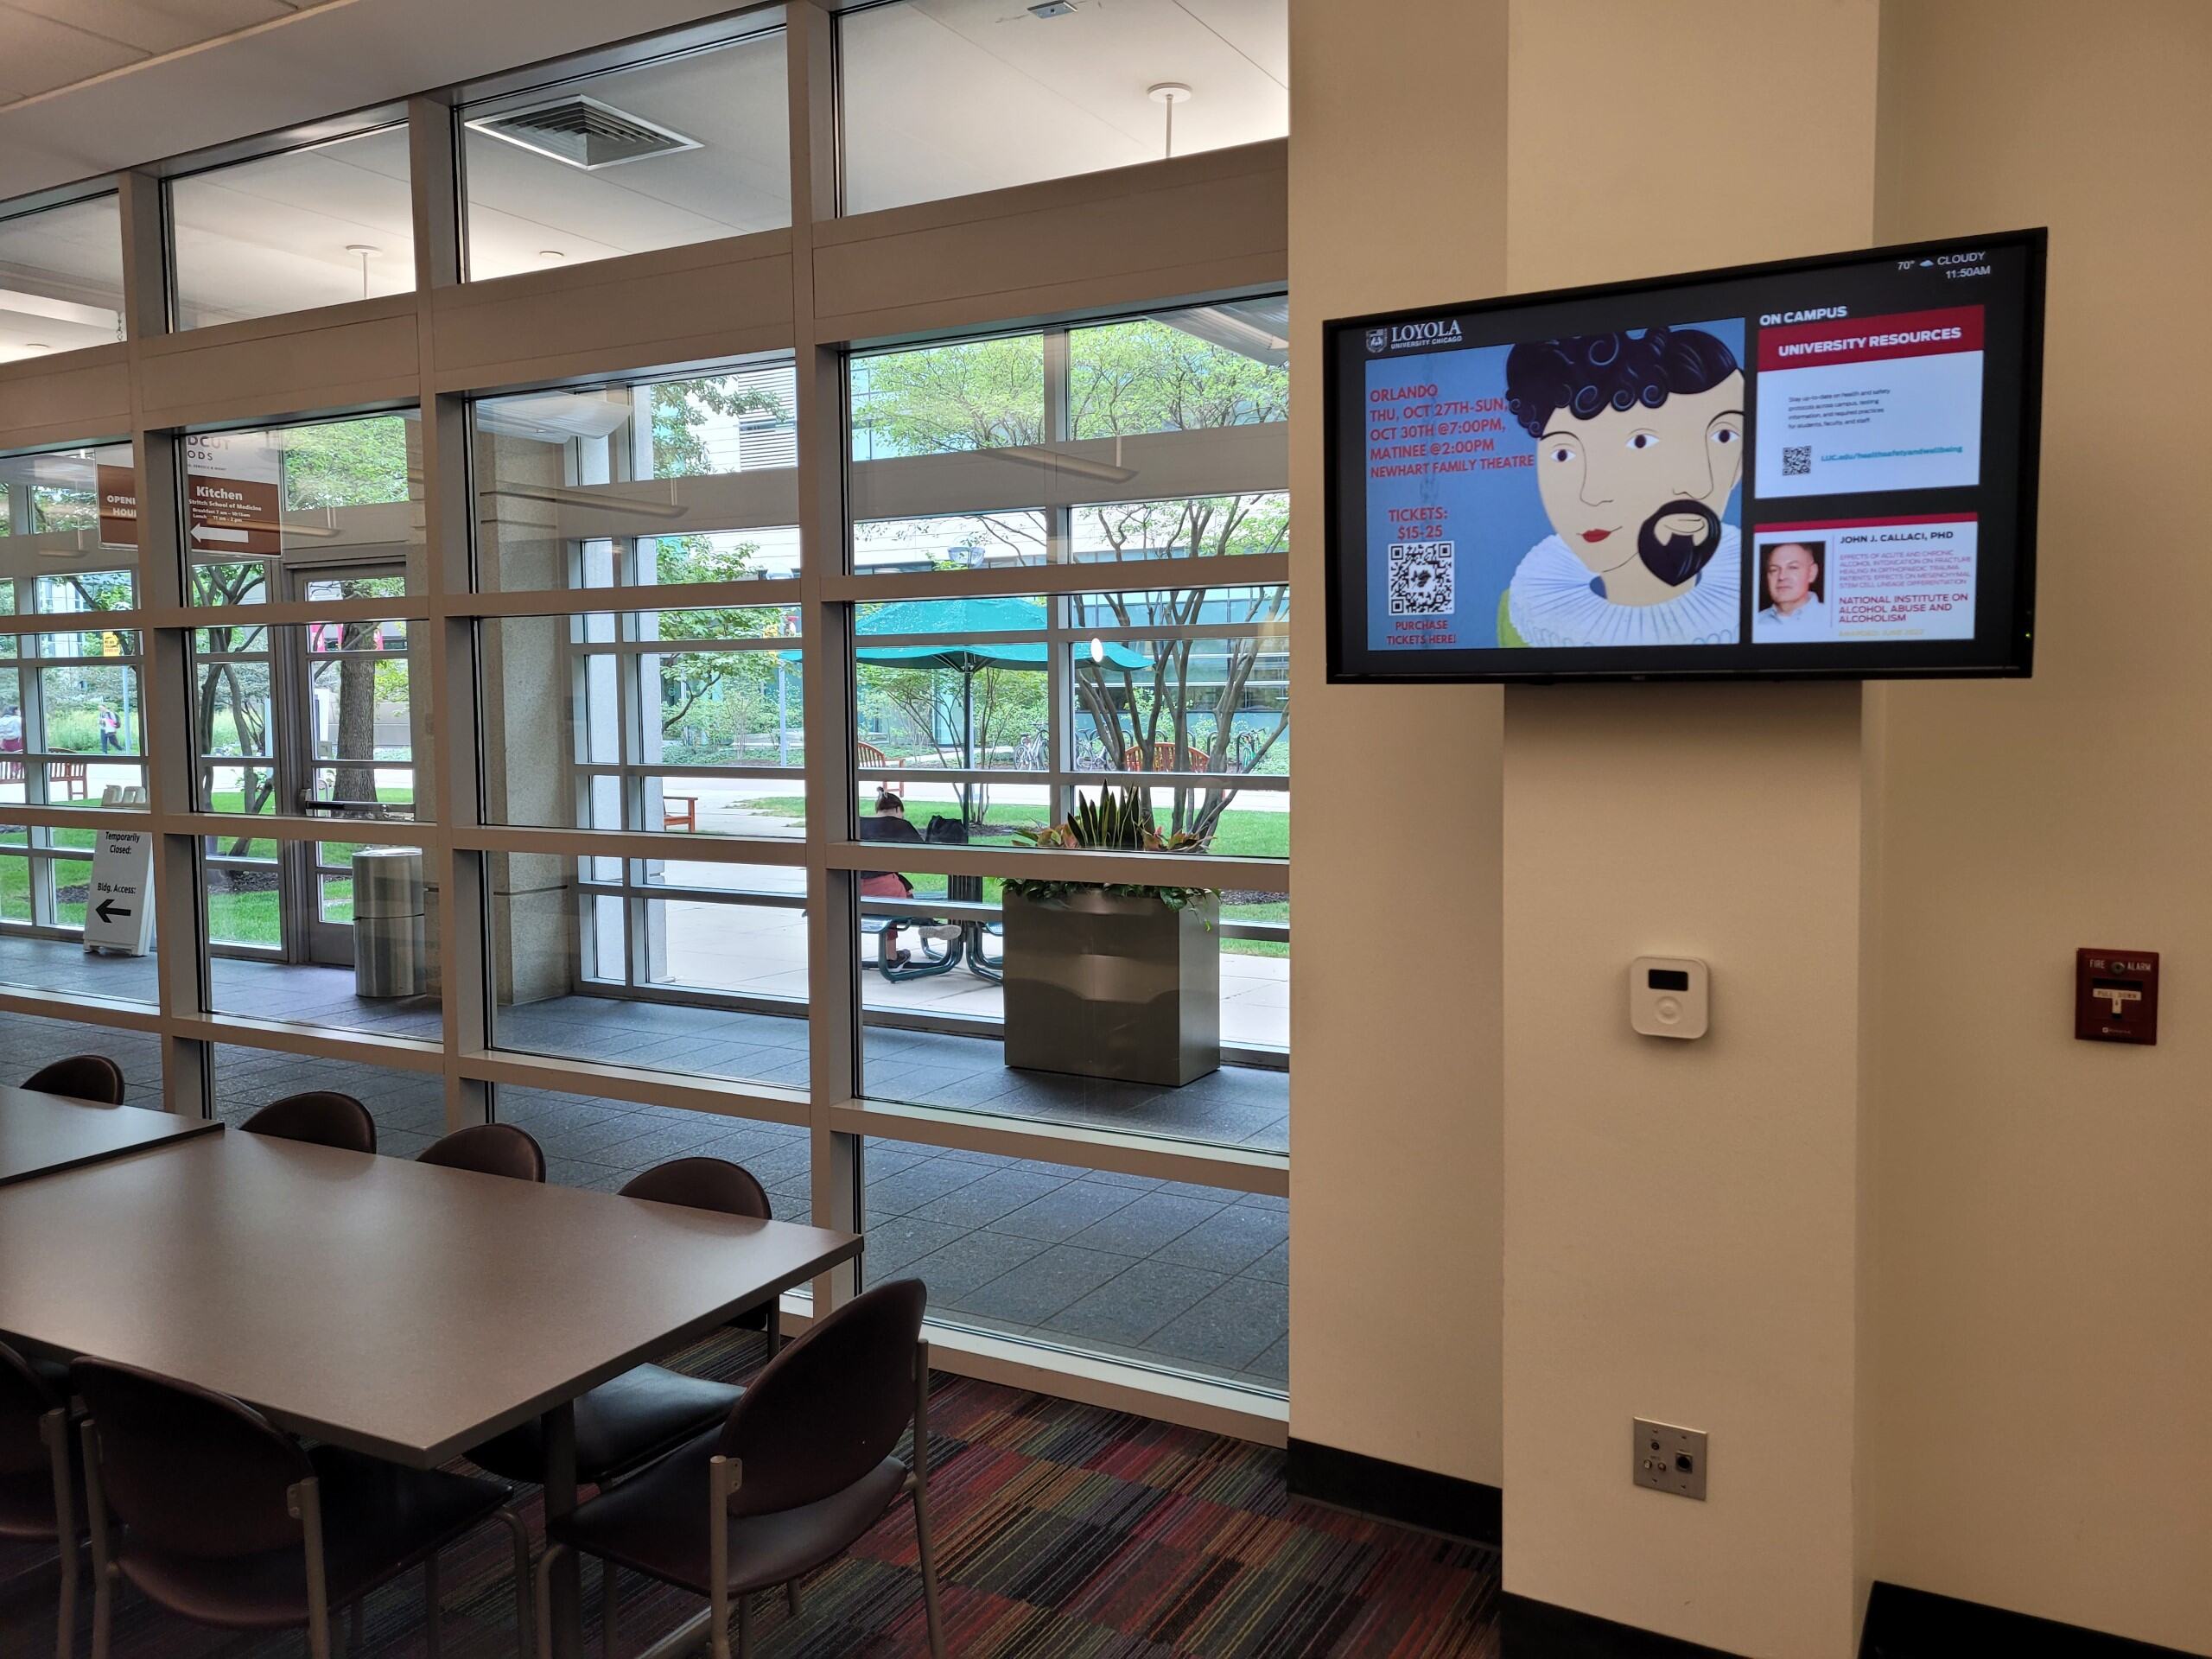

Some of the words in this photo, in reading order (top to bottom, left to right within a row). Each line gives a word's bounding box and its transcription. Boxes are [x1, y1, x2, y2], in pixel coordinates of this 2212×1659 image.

[1937, 251, 1986, 265] CLOUDY
[1946, 265, 1991, 279] 11:50AM
[1759, 313, 1782, 326] ON
[1783, 306, 1848, 323] CAMPUS
[1391, 320, 1462, 342] LOYOLA
[1391, 340, 1430, 350] UNIVERSITY
[1431, 335, 1462, 345] CHICAGO
[1778, 336, 1866, 357] UNIVERSITY
[1869, 327, 1962, 347] RESOURCES
[1370, 384, 1438, 403] ORLANDO
[1370, 409, 1400, 423] THU,
[1403, 404, 1432, 420] OCT
[1370, 427, 1397, 442] OCT
[1401, 423, 1434, 438] 30TH
[1438, 418, 1507, 435] @7:00PM,
[1370, 444, 1426, 461] MATINEE
[1430, 439, 1494, 455] @2:00PM
[1370, 463, 1428, 478] NEWHART
[1432, 459, 1476, 474] FAMILY
[1479, 454, 1535, 470] THEATRE
[196, 486, 243, 501] Kitchen
[208, 500, 228, 509] School
[236, 504, 262, 512] Medicine
[1389, 507, 1448, 523] TICKETS:
[1397, 524, 1443, 540] $15-25
[1840, 536, 1868, 544] JOHN
[1870, 534, 1878, 543] J.
[1880, 532, 1928, 543] CALLACI,
[1930, 531, 1955, 540] PHD
[1839, 595, 1892, 604] NATIONAL
[1894, 594, 1950, 602] INSTITUTE
[1951, 593, 1969, 601] ON
[1839, 605, 1889, 614] ALCOHOL
[1839, 614, 1908, 623] ALCOHOLISM
[1395, 620, 1449, 632] PURCHASE
[1387, 635, 1428, 645] TICKETS
[1428, 634, 1456, 645] HERE!
[105, 831, 141, 843] Temporarily
[110, 845, 132, 855] Closed:
[98, 882, 112, 893] Bldg.
[113, 885, 137, 894] Access:
[2089, 959, 2107, 969] FIRE
[2126, 962, 2152, 971] ALARM
